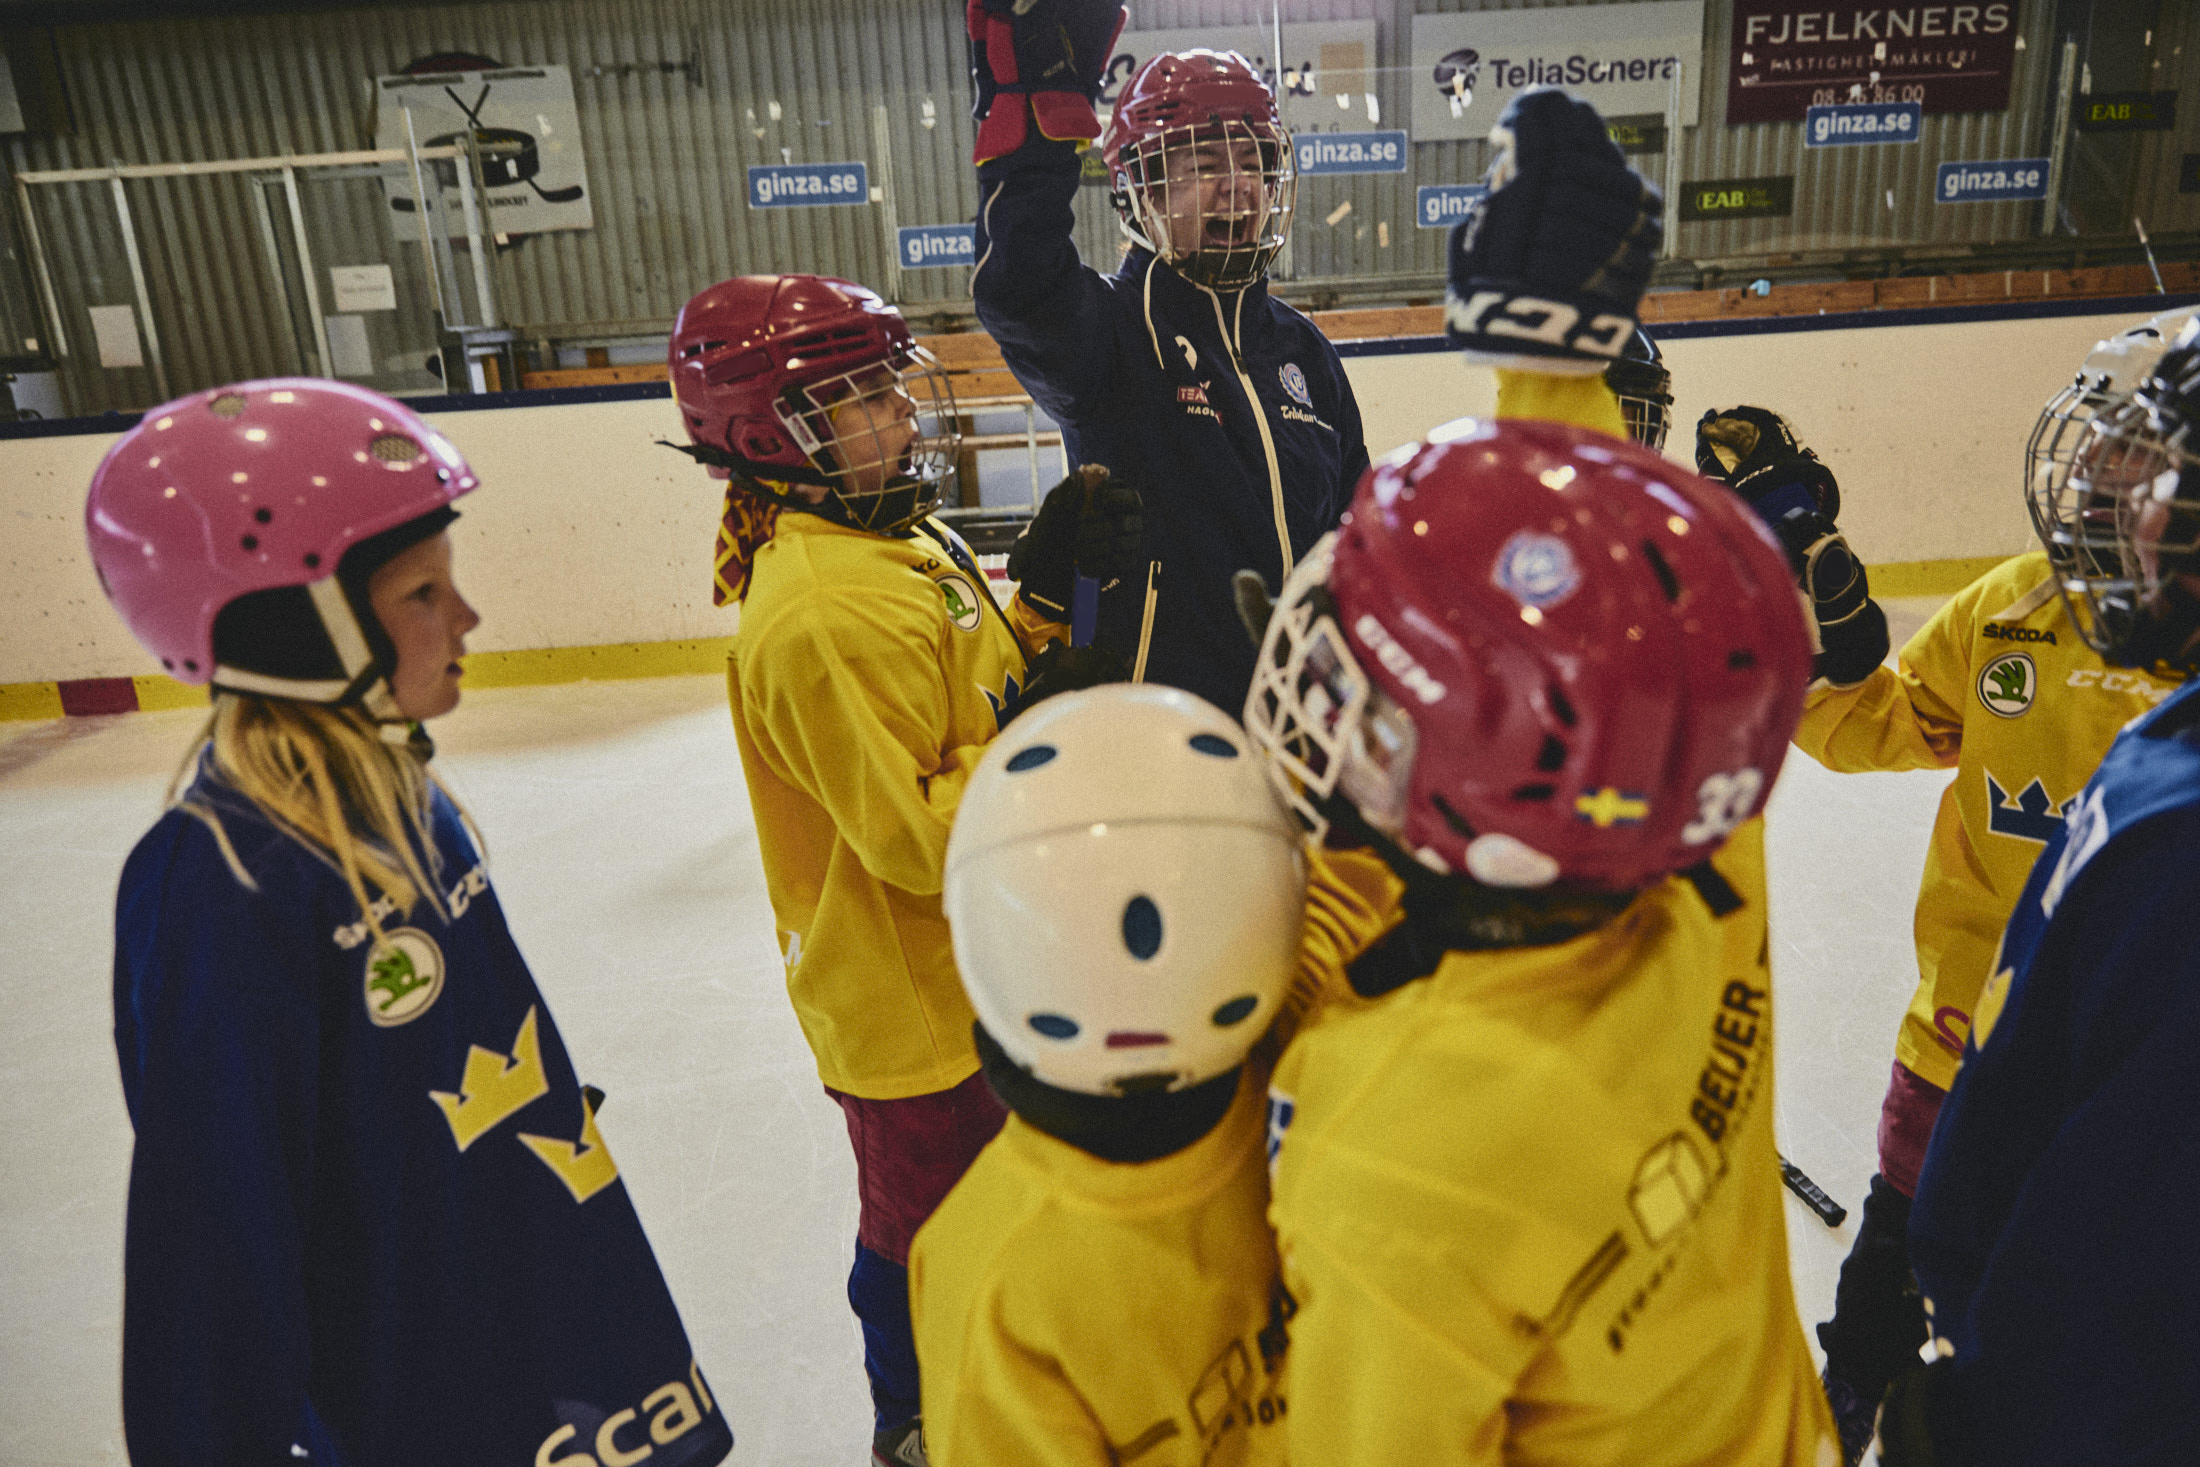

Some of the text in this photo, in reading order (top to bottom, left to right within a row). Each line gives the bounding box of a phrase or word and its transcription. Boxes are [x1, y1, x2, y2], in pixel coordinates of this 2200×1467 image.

[1745, 3, 2010, 45] FJELKNERS
[1489, 54, 1677, 89] TeliaSonera
[1814, 111, 1913, 142] ginza.se
[2090, 103, 2132, 120] EAB
[1299, 139, 1398, 170] ginza.se
[756, 171, 859, 203] ginza.se
[1944, 167, 2040, 198] ginza.se
[1425, 191, 1485, 222] ginz
[1701, 189, 1744, 210] EAB
[1982, 621, 2058, 647] ŠKODA
[1689, 977, 1766, 1144] BEIJER
